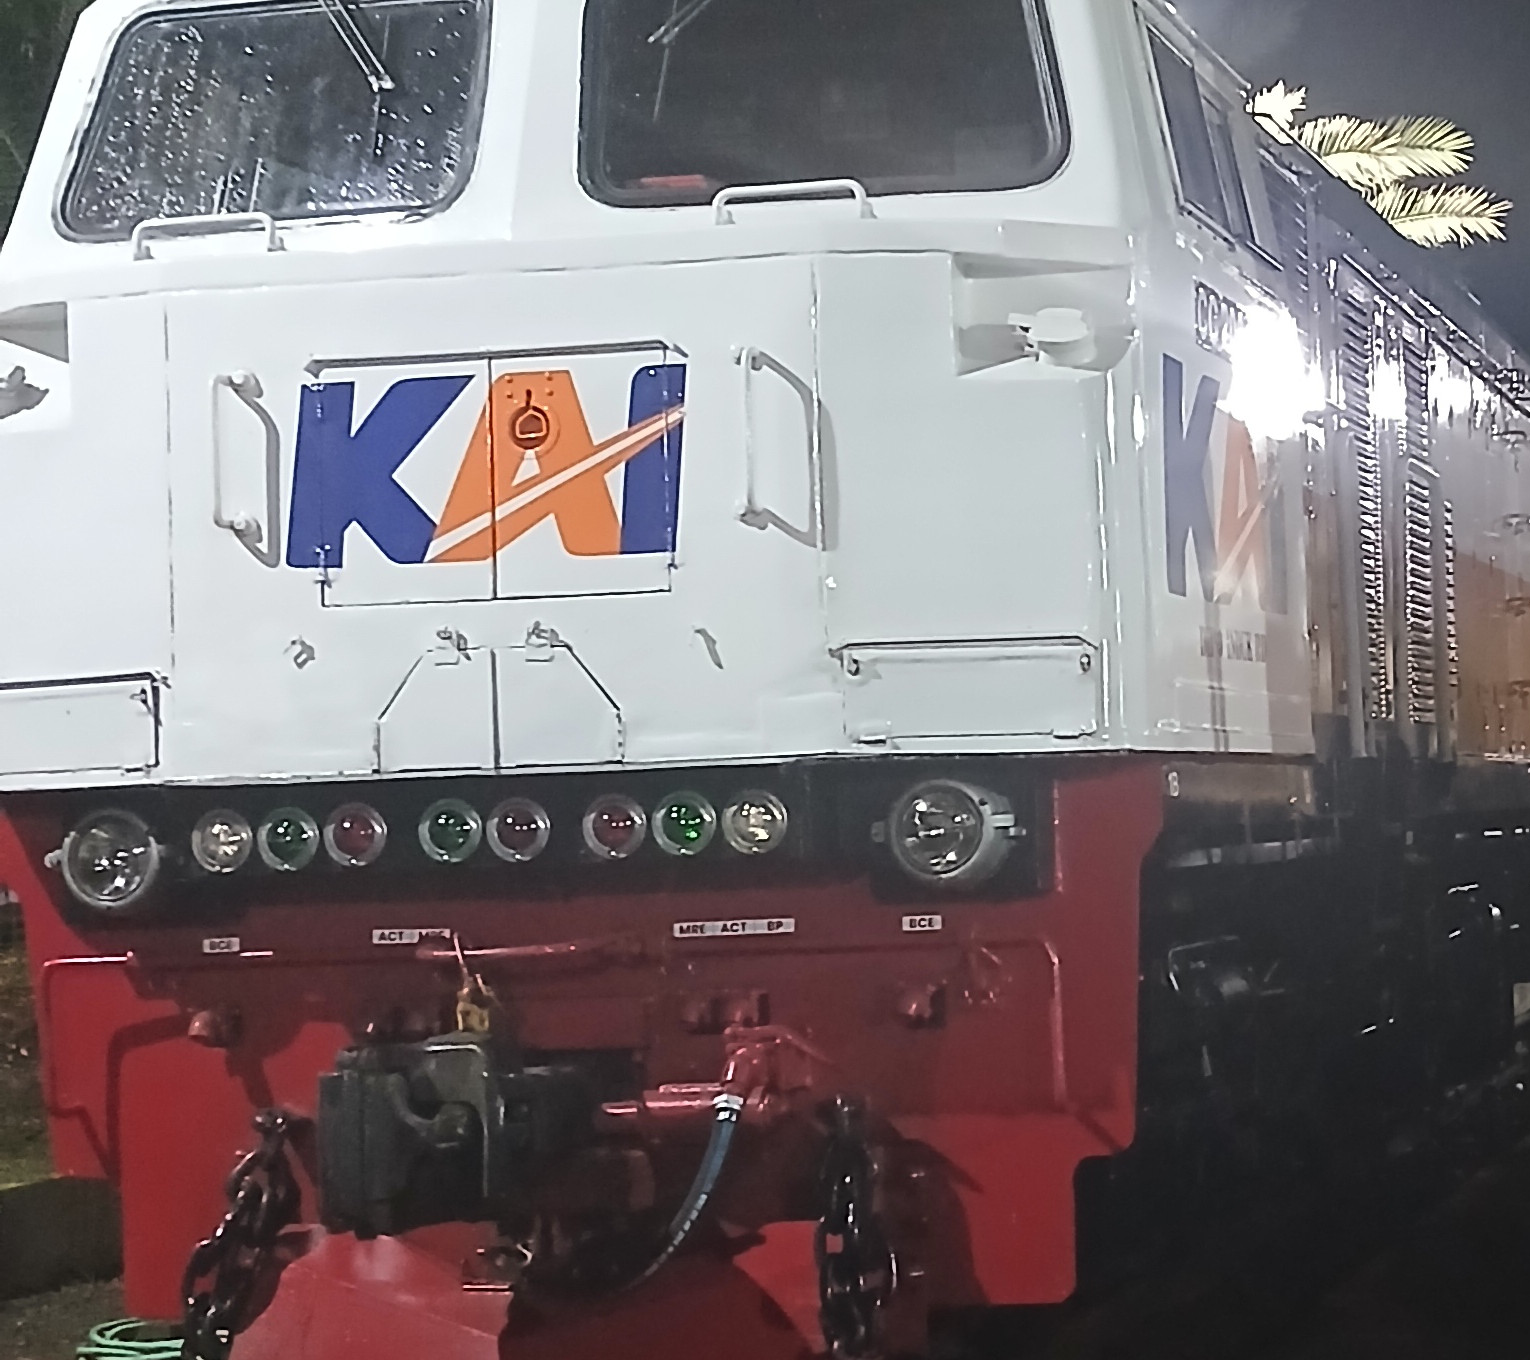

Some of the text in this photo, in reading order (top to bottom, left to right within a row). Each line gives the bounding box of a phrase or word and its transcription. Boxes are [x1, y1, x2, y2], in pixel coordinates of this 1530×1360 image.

[286, 363, 687, 569] KAI
[720, 922, 747, 933] ACT
[378, 931, 405, 942] ACT
